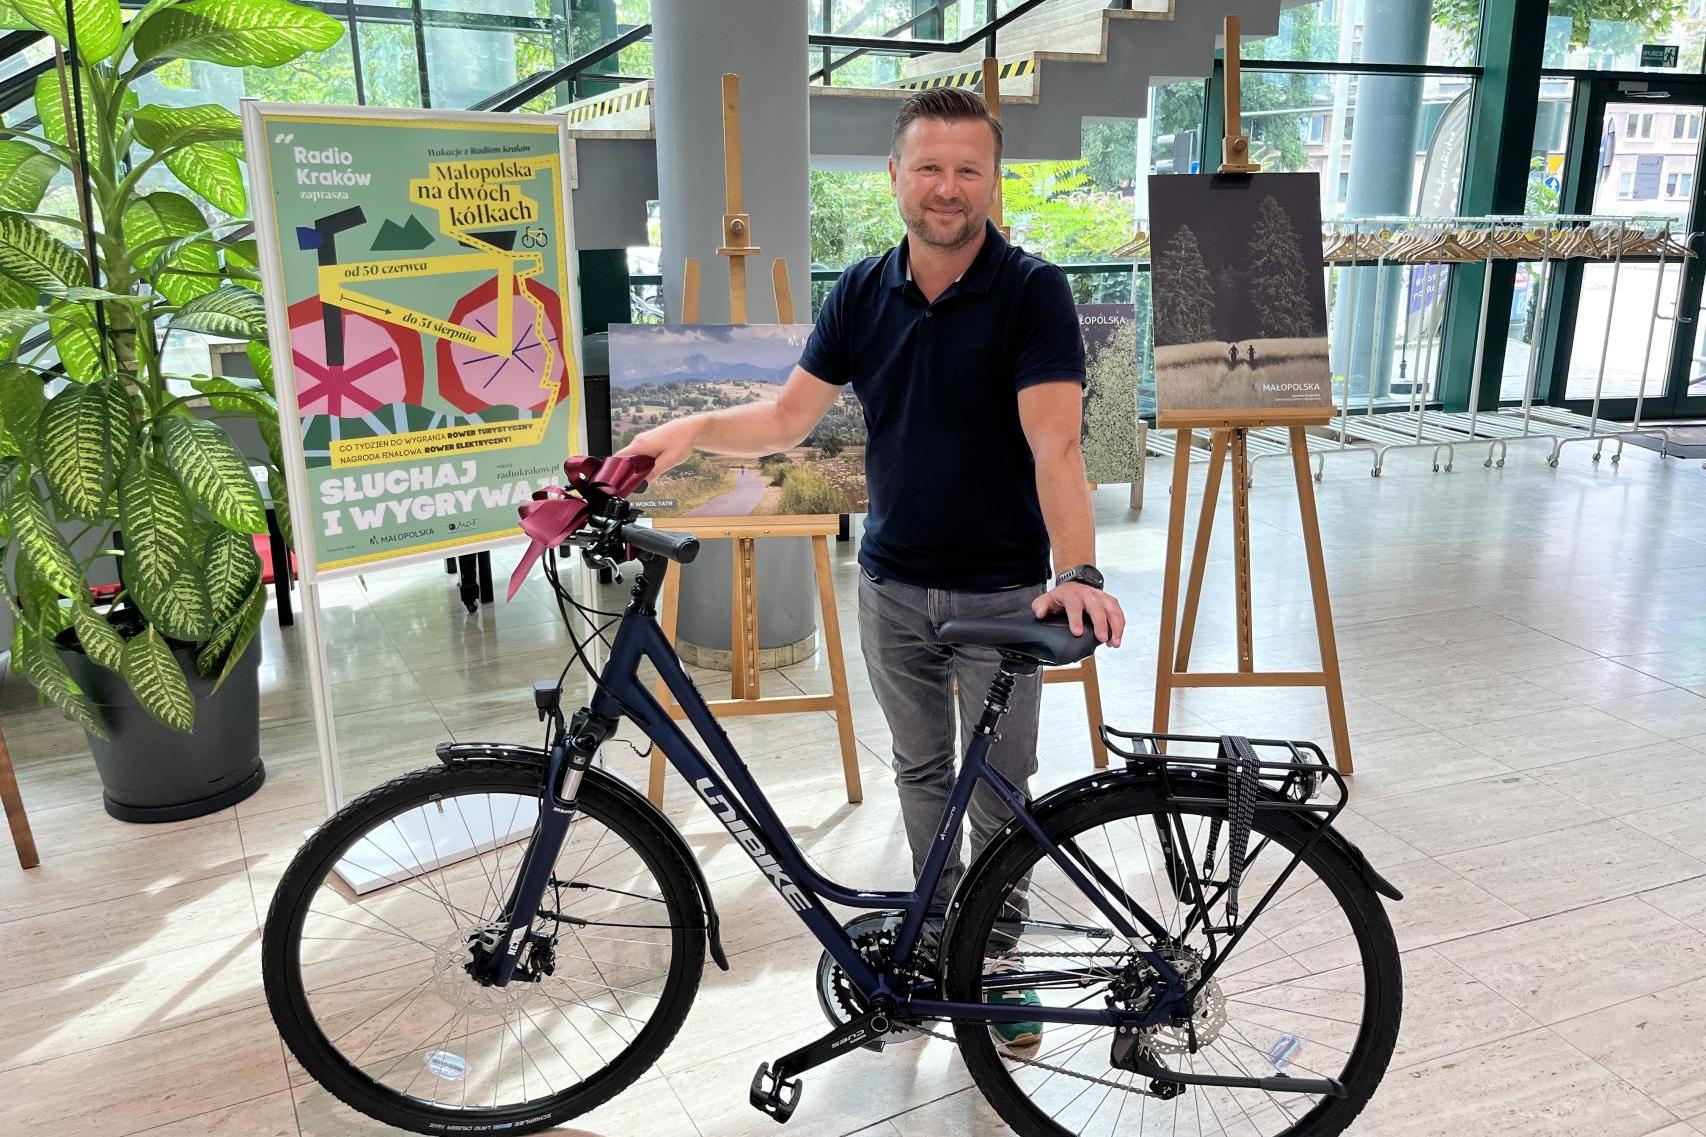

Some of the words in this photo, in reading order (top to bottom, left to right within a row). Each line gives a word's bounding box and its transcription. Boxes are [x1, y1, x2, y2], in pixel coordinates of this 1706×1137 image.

[294, 146, 353, 165] Radio
[427, 147, 462, 157] Wakacje
[296, 168, 371, 186] Kraków
[435, 162, 532, 183] Małopolska
[300, 191, 349, 202] zaprasza
[417, 185, 442, 199] na
[448, 182, 510, 202] dwóch
[449, 200, 532, 227] kółkach
[344, 265, 360, 278] od
[381, 262, 428, 274] czerwca
[402, 312, 418, 325] do
[433, 322, 477, 343] sierpnia
[1080, 316, 1126, 325] ŁOPOLSKA
[1262, 383, 1320, 392] MAŁOPOLSKA
[339, 444, 353, 452] CO
[390, 438, 403, 447] DO
[404, 433, 446, 444] WYGRANIA
[447, 429, 476, 439] ROWER
[477, 423, 534, 435] TURYSTYCZNY
[340, 453, 380, 464] NAGRODA
[381, 448, 422, 459] FINAŁOWA
[424, 443, 455, 454] ROWER
[319, 460, 477, 505] SŁUCHAJ
[322, 510, 343, 537] I
[380, 528, 435, 545] MAŁOPOLSKA
[695, 776, 813, 912] UNIBIKE
[514, 1112, 552, 1127] SCHWALBE
